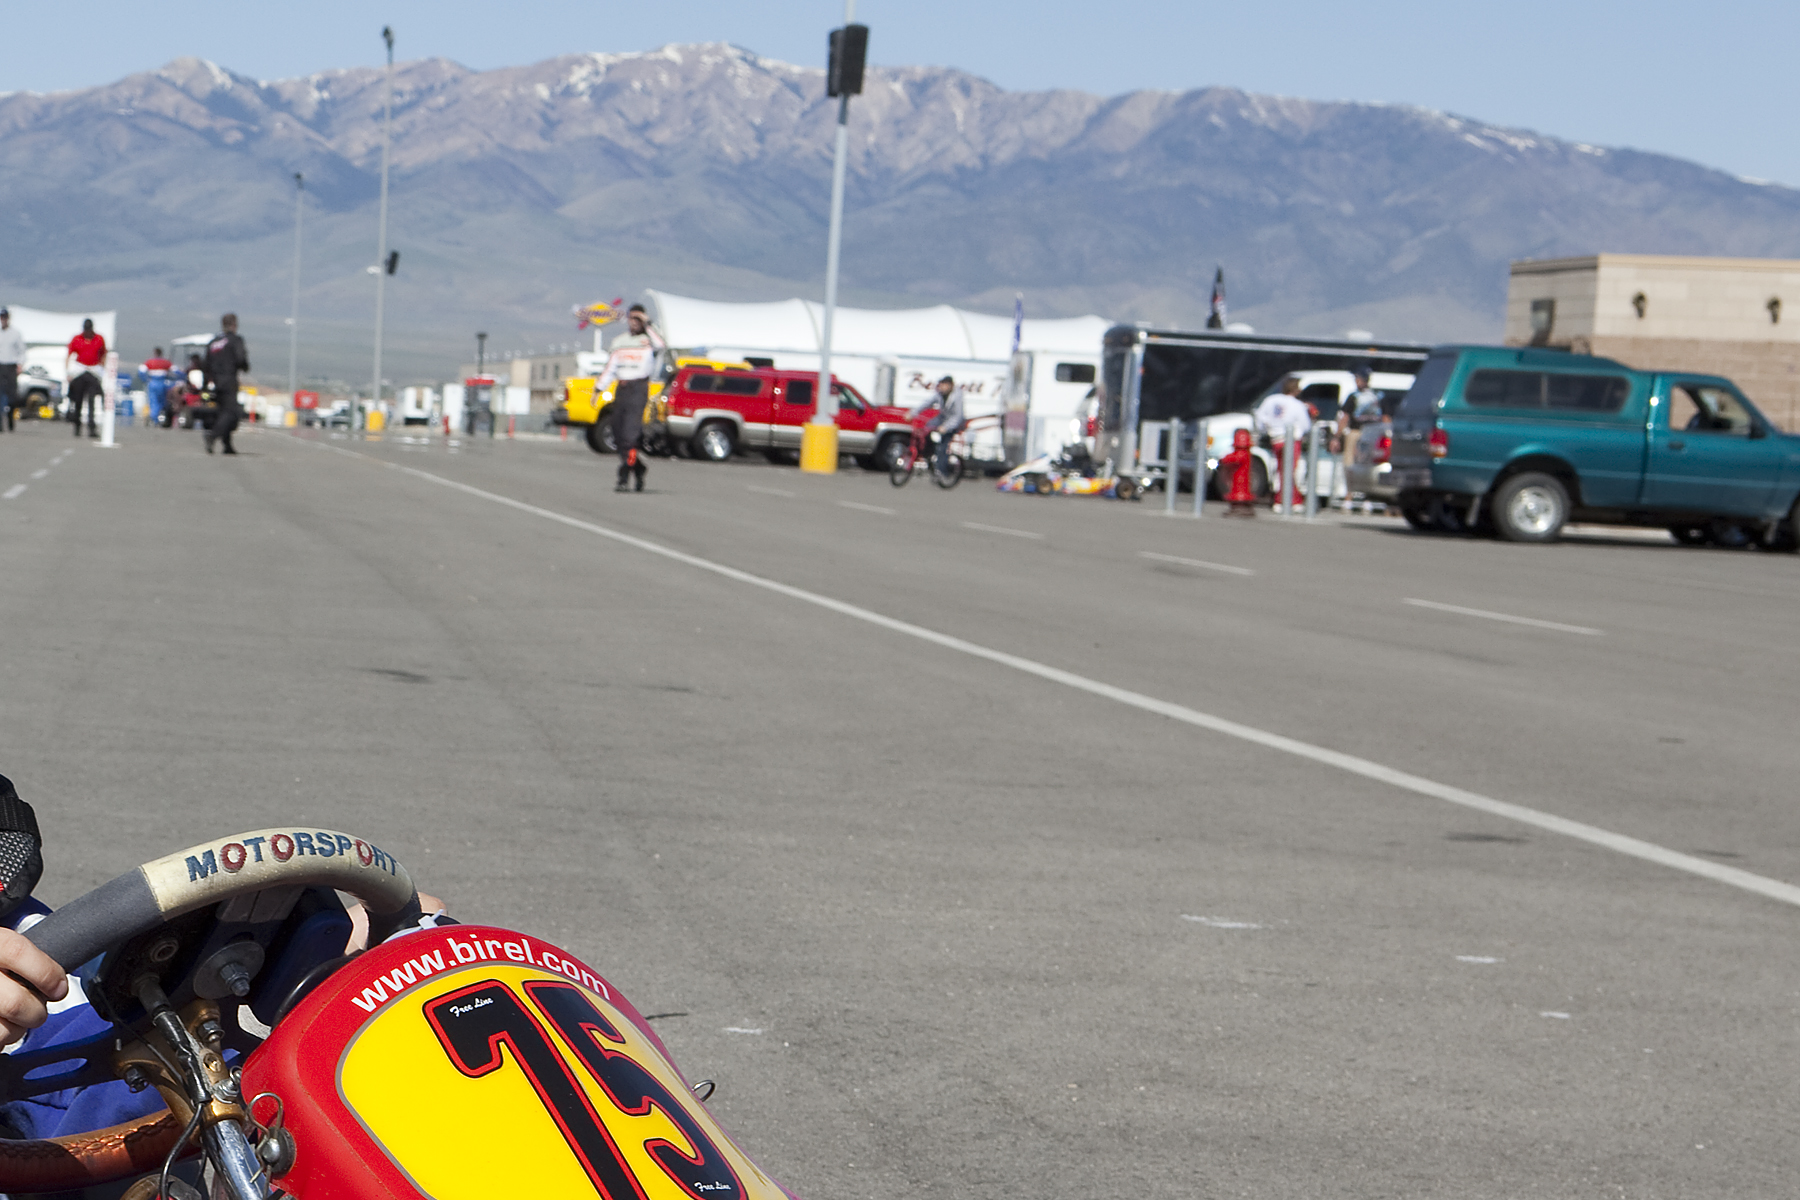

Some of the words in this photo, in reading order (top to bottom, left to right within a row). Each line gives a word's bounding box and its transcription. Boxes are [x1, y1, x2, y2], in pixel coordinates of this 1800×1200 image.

[185, 832, 397, 883] MOTORSPORT
[351, 934, 610, 1012] www.birel.com
[450, 1004, 473, 1017] Free
[474, 997, 494, 1009] Line
